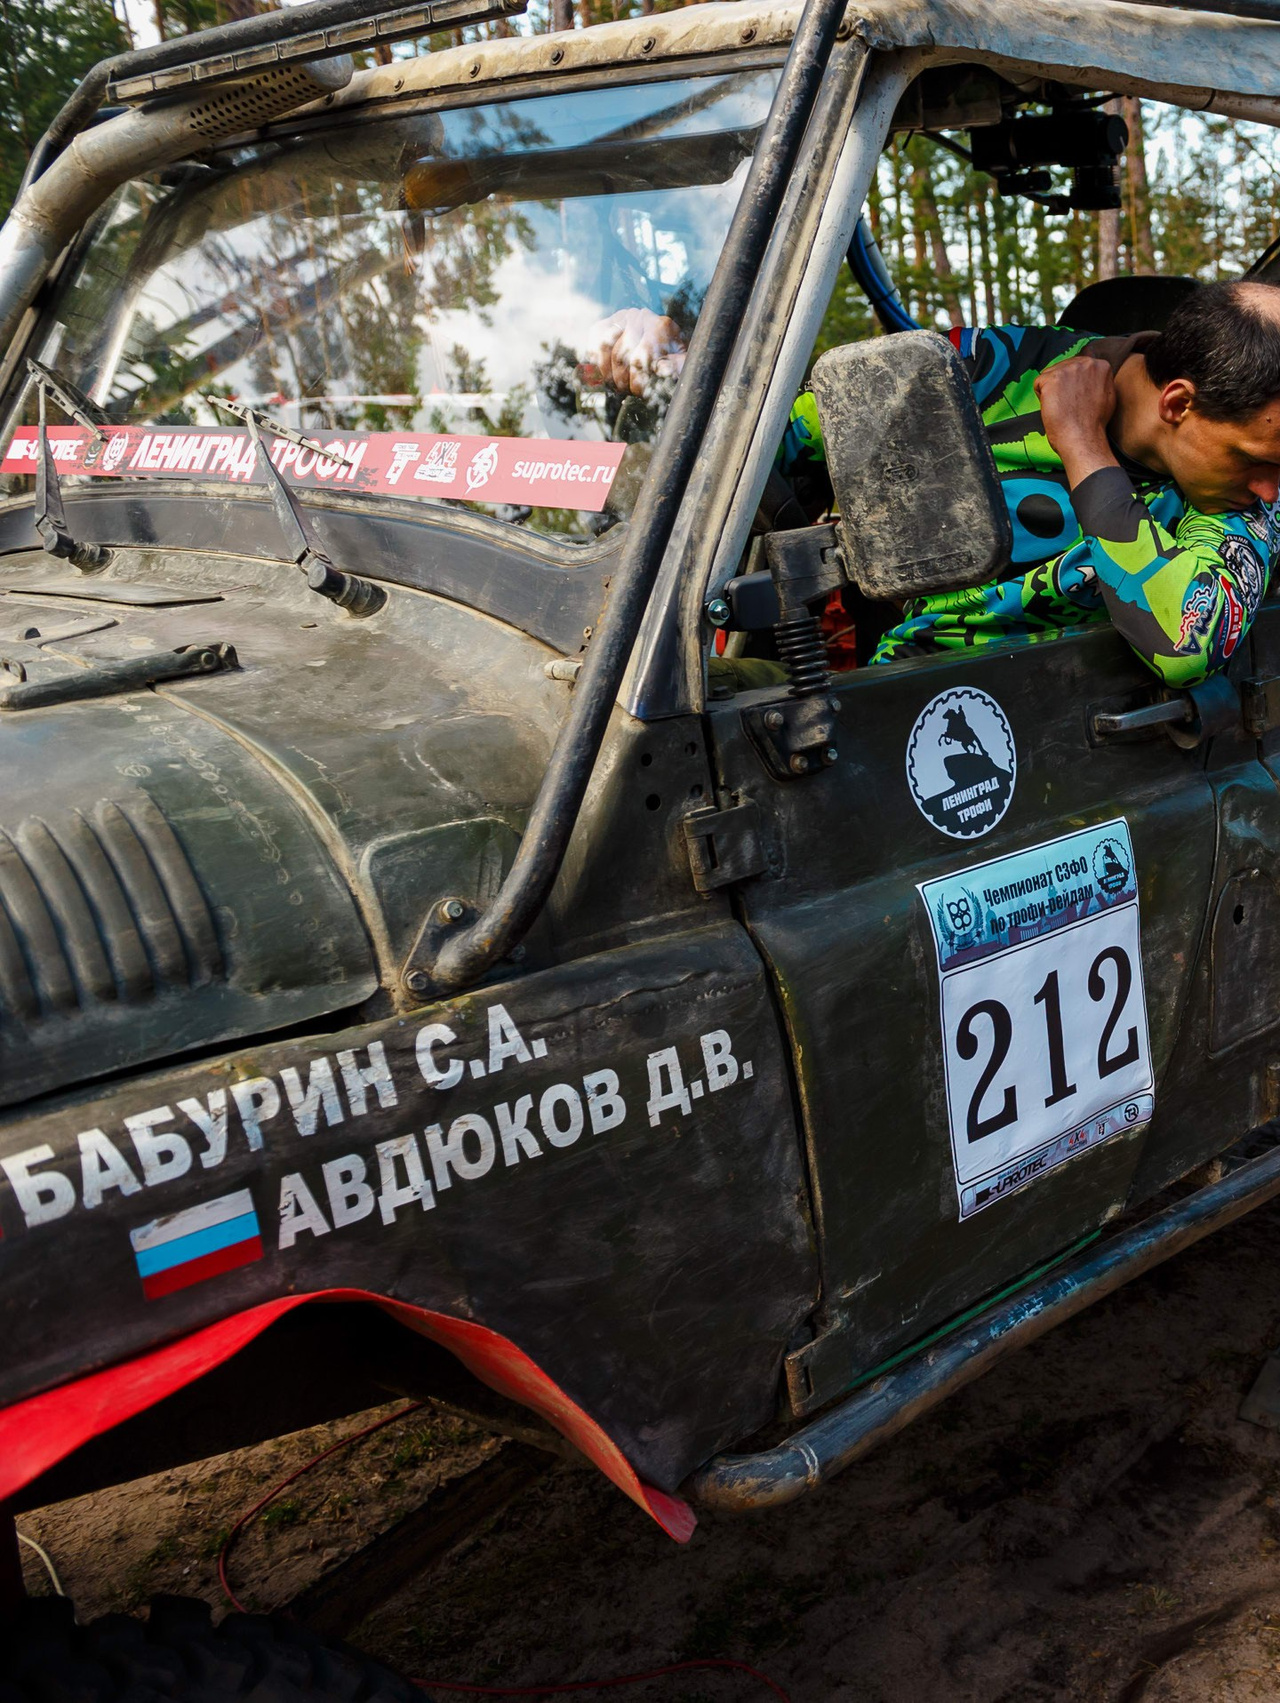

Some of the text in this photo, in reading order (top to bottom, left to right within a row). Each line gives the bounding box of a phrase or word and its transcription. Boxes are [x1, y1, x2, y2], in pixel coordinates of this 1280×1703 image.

[129, 434, 257, 479] ЛЕНИНГРАД
[271, 438, 369, 480] ТРОФИ
[511, 459, 617, 484] suprotec.ru
[942, 776, 1000, 812] ЛЕНИНГРАД
[957, 798, 993, 824] ТРОФИ
[983, 870, 1053, 907] Чемпионат
[990, 883, 1095, 936] по трофи-рейдам
[955, 945, 1140, 1144] 212
[0, 1003, 549, 1229] БАБУРИН С.А.
[278, 1028, 755, 1250] АВДЮКОВ Д.В.
[988, 1153, 1049, 1195] SUPROTEC
